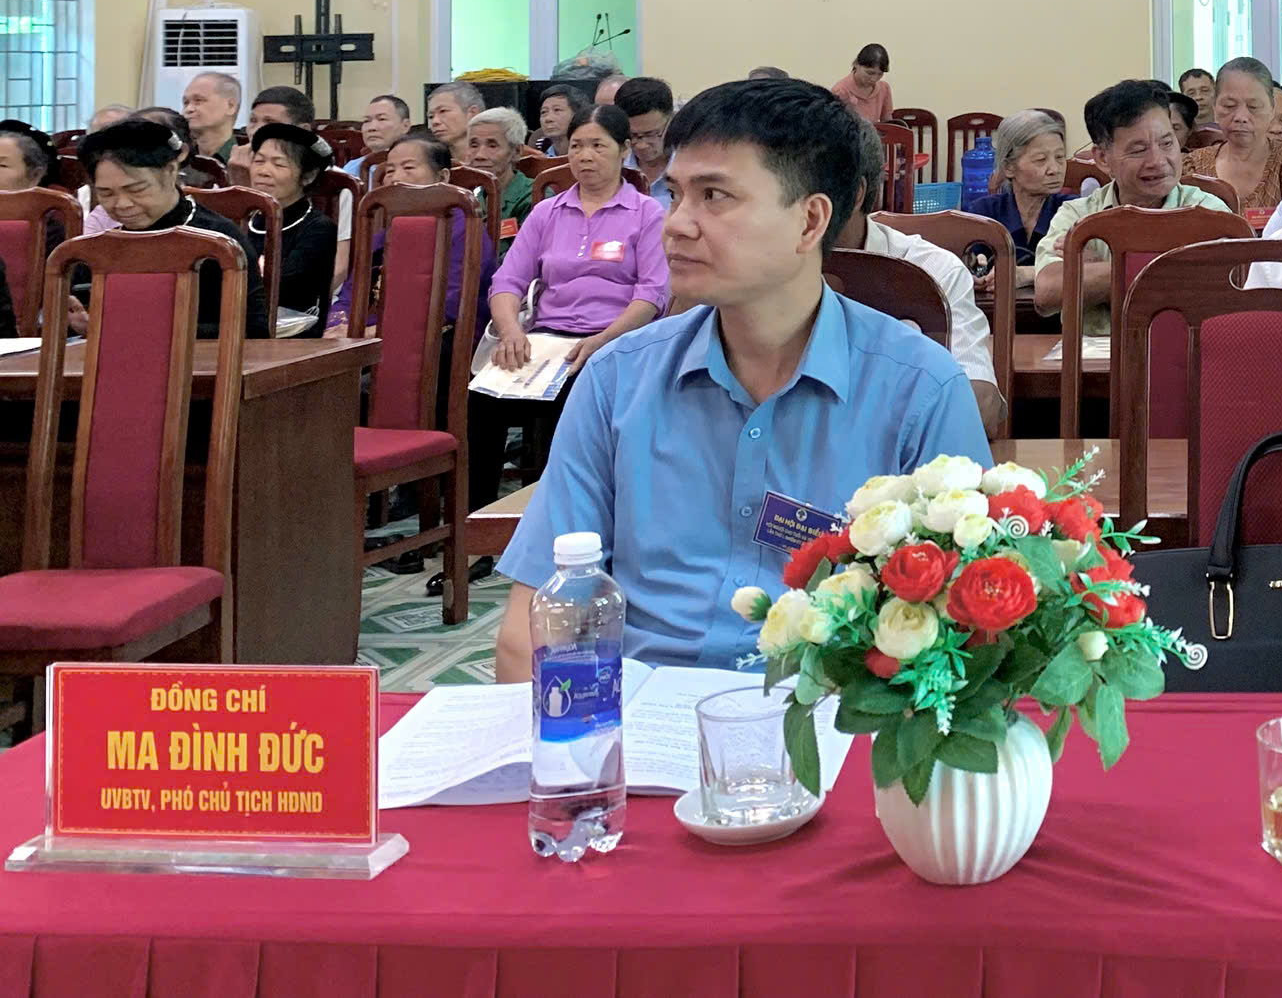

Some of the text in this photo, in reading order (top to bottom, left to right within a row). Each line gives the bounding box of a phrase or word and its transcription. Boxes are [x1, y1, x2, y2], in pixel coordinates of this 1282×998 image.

[150, 680, 266, 713] ĐỒNG CHÍ
[107, 721, 325, 774] MA ĐÌNH ĐỨC
[100, 788, 156, 814] UVBTV,
[160, 785, 194, 812] PHÓ
[198, 781, 231, 812] CHỦ
[235, 790, 273, 817] TỊCH
